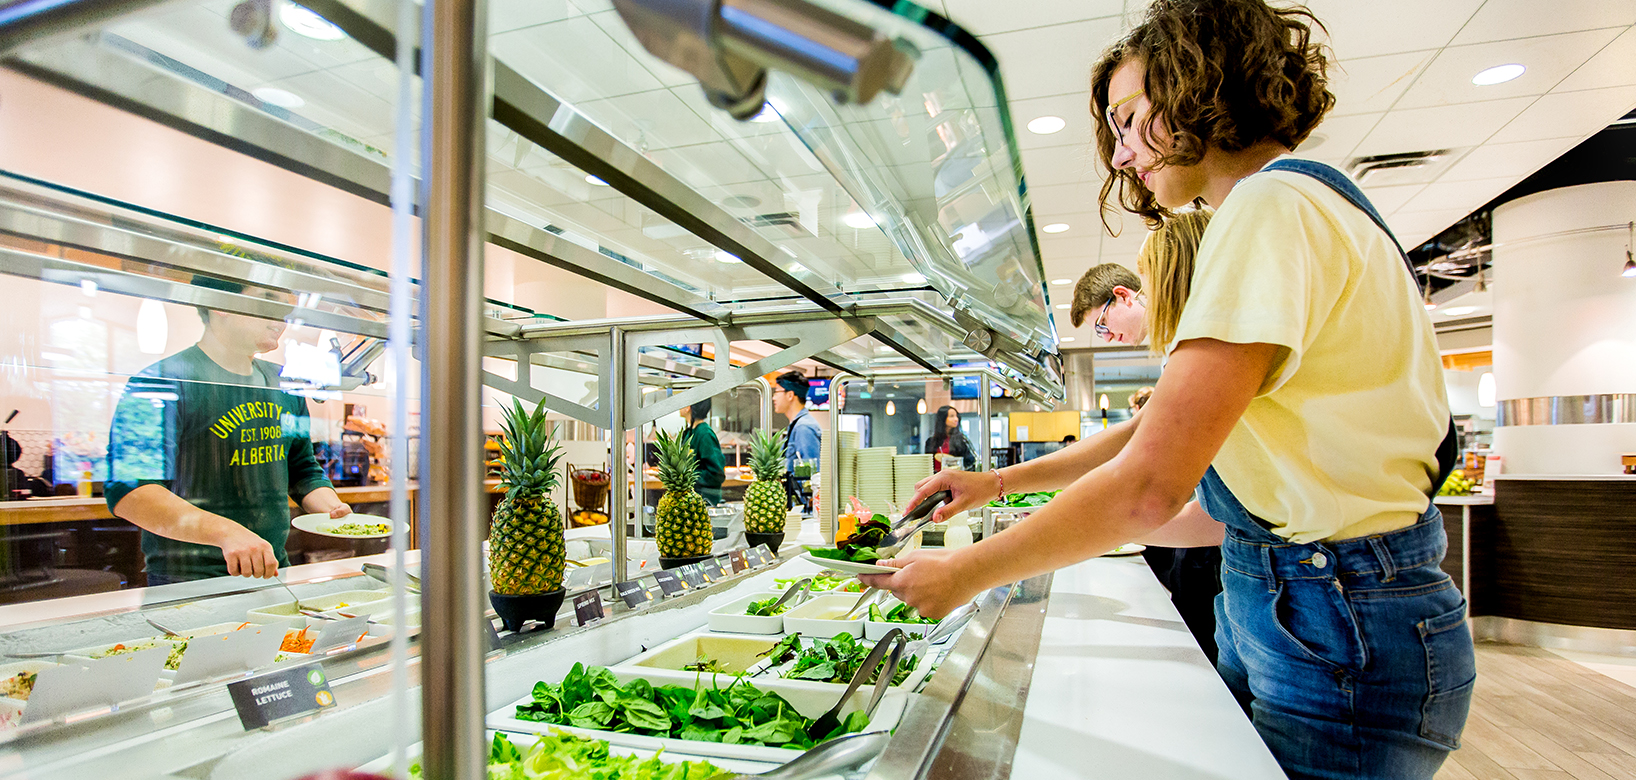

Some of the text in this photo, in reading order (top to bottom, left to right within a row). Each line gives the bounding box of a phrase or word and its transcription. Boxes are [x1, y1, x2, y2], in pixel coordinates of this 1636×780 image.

[209, 401, 283, 439] UNIVERSITY
[240, 425, 282, 443] EST. 1908
[229, 444, 286, 466] ALBERTA
[251, 681, 289, 695] ROMAINE
[256, 690, 292, 705] LETTUCE
